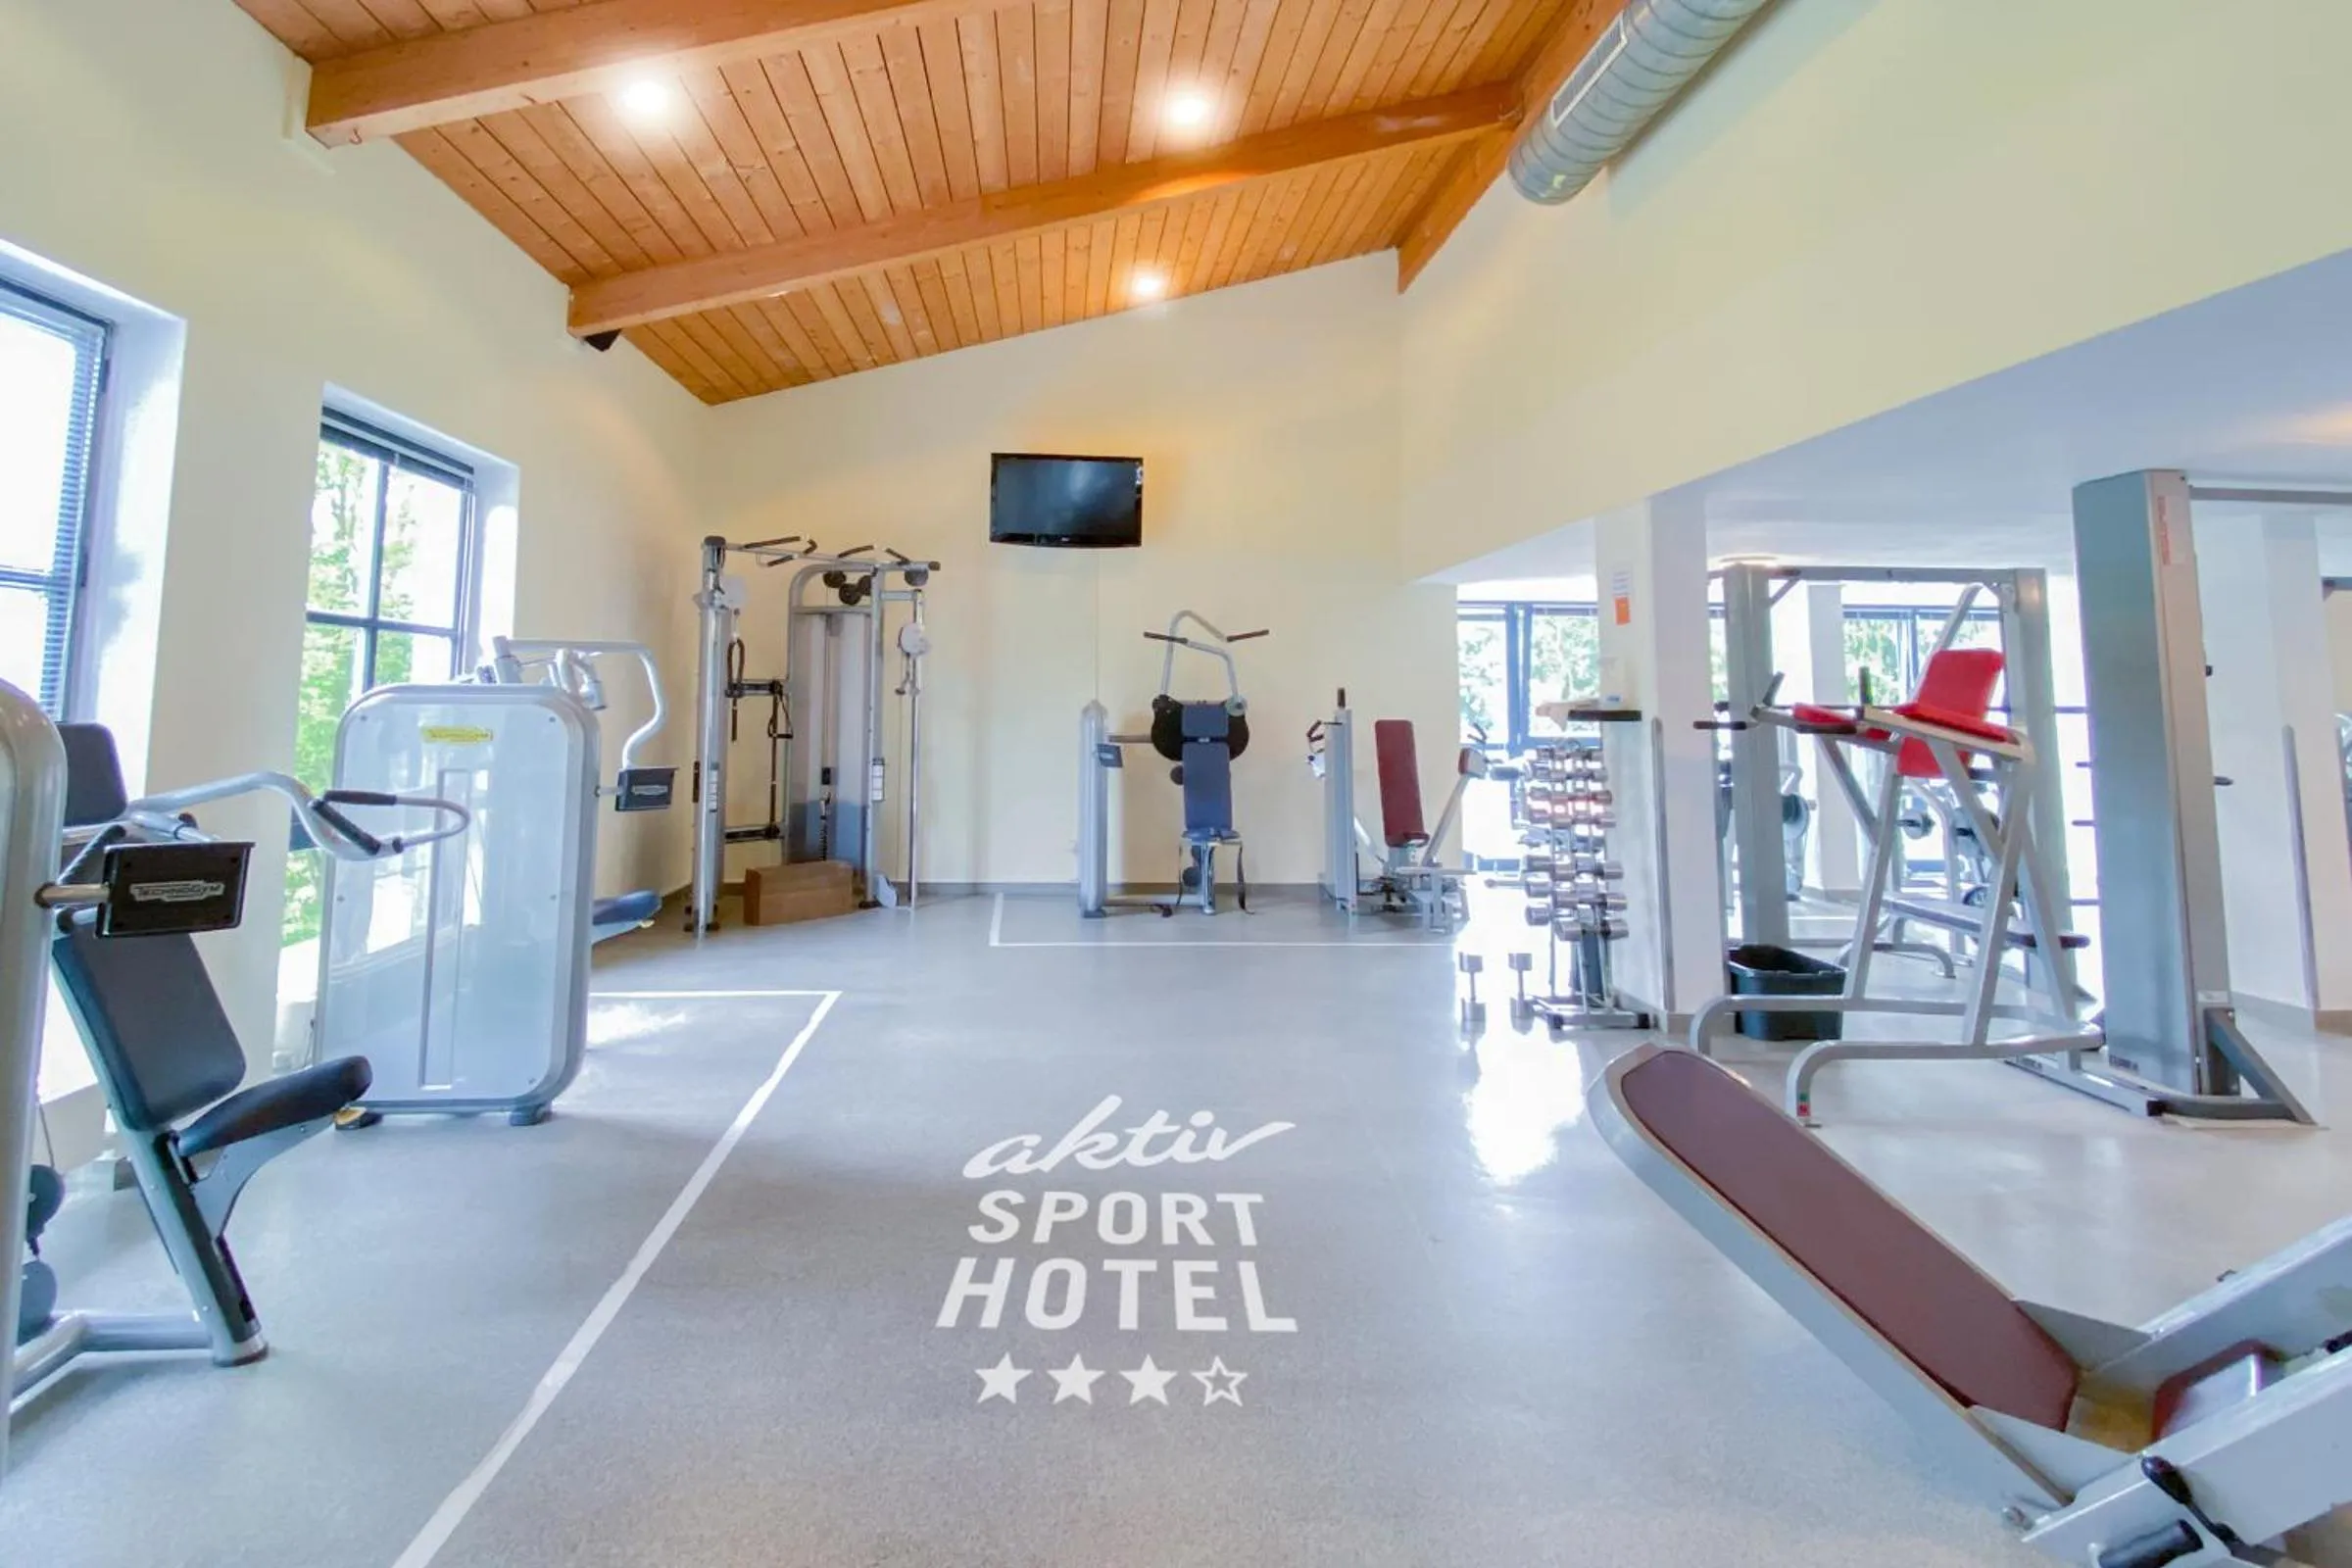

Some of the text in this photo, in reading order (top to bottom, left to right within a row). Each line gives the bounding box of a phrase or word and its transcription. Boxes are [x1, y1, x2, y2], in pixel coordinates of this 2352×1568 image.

[961, 1095, 1297, 1179] aktiv
[967, 1190, 1264, 1247] SPORT
[935, 1257, 1298, 1332] HOTEL
